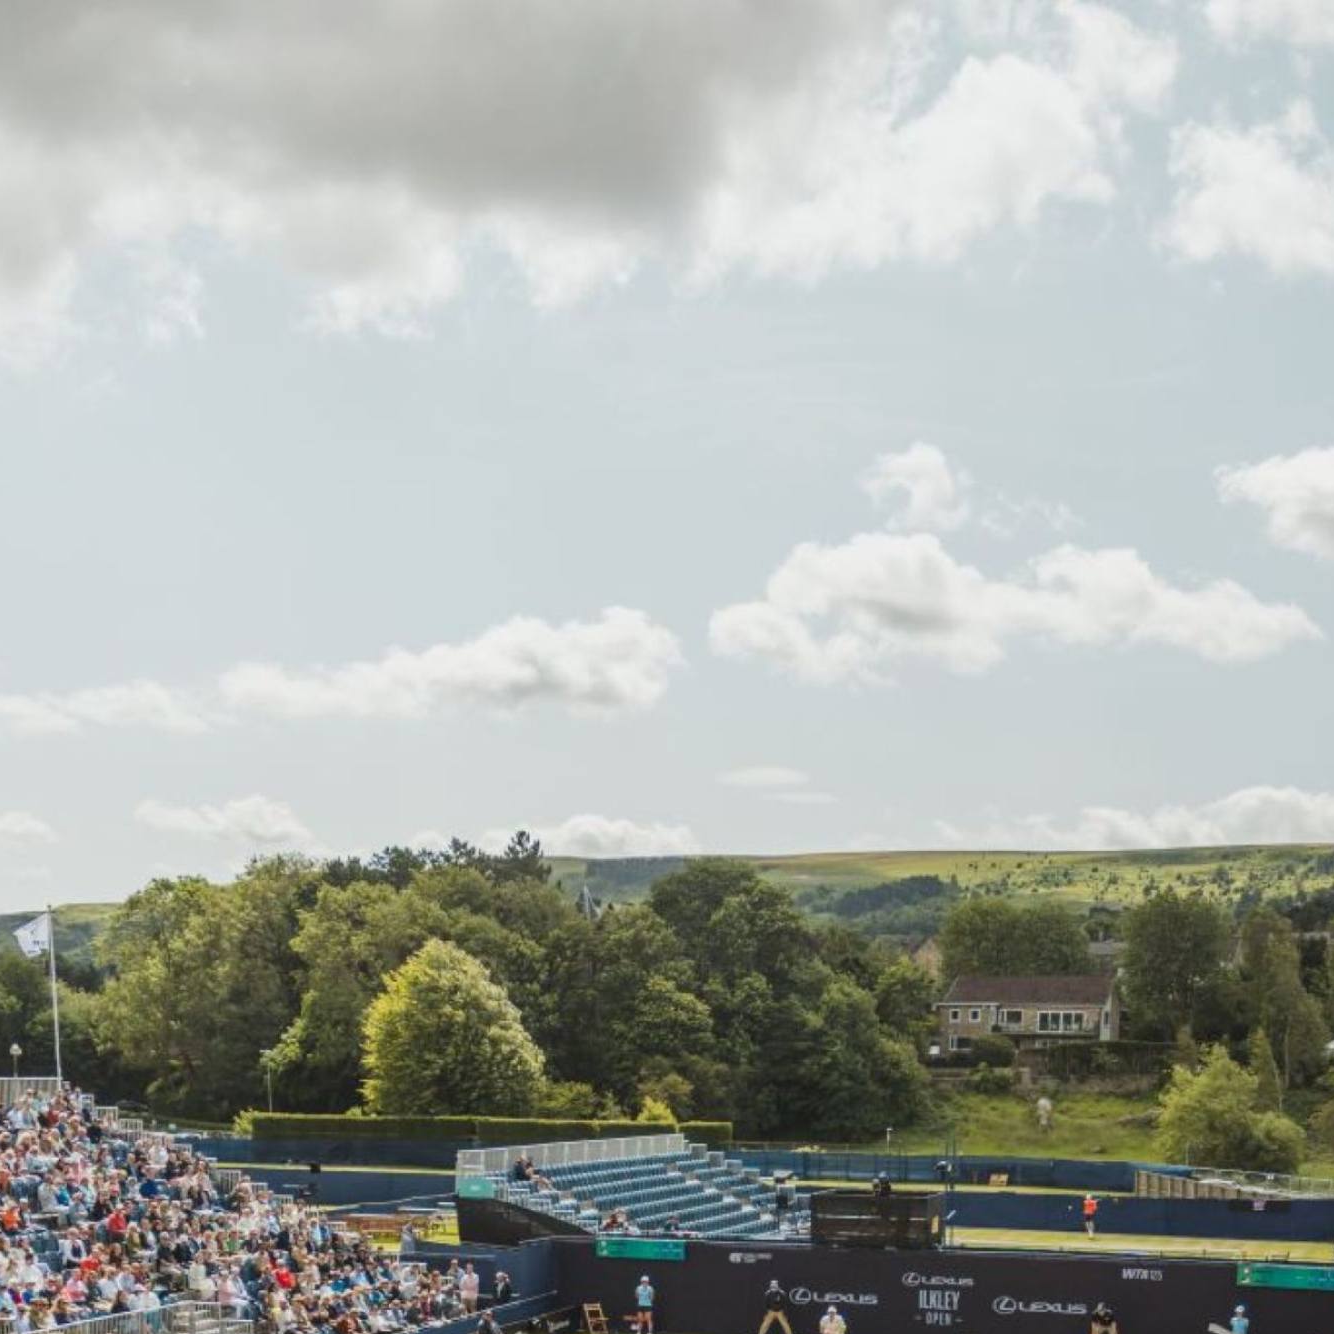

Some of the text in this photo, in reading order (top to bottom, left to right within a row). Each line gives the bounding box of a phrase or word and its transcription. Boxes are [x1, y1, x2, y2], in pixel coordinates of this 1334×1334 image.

[921, 1275, 974, 1287] LEXUS
[813, 1291, 878, 1305] LEXUS
[919, 1289, 960, 1311] ILKLEY
[1017, 1301, 1087, 1314] LEXUS
[925, 1312, 952, 1326] OPEN
